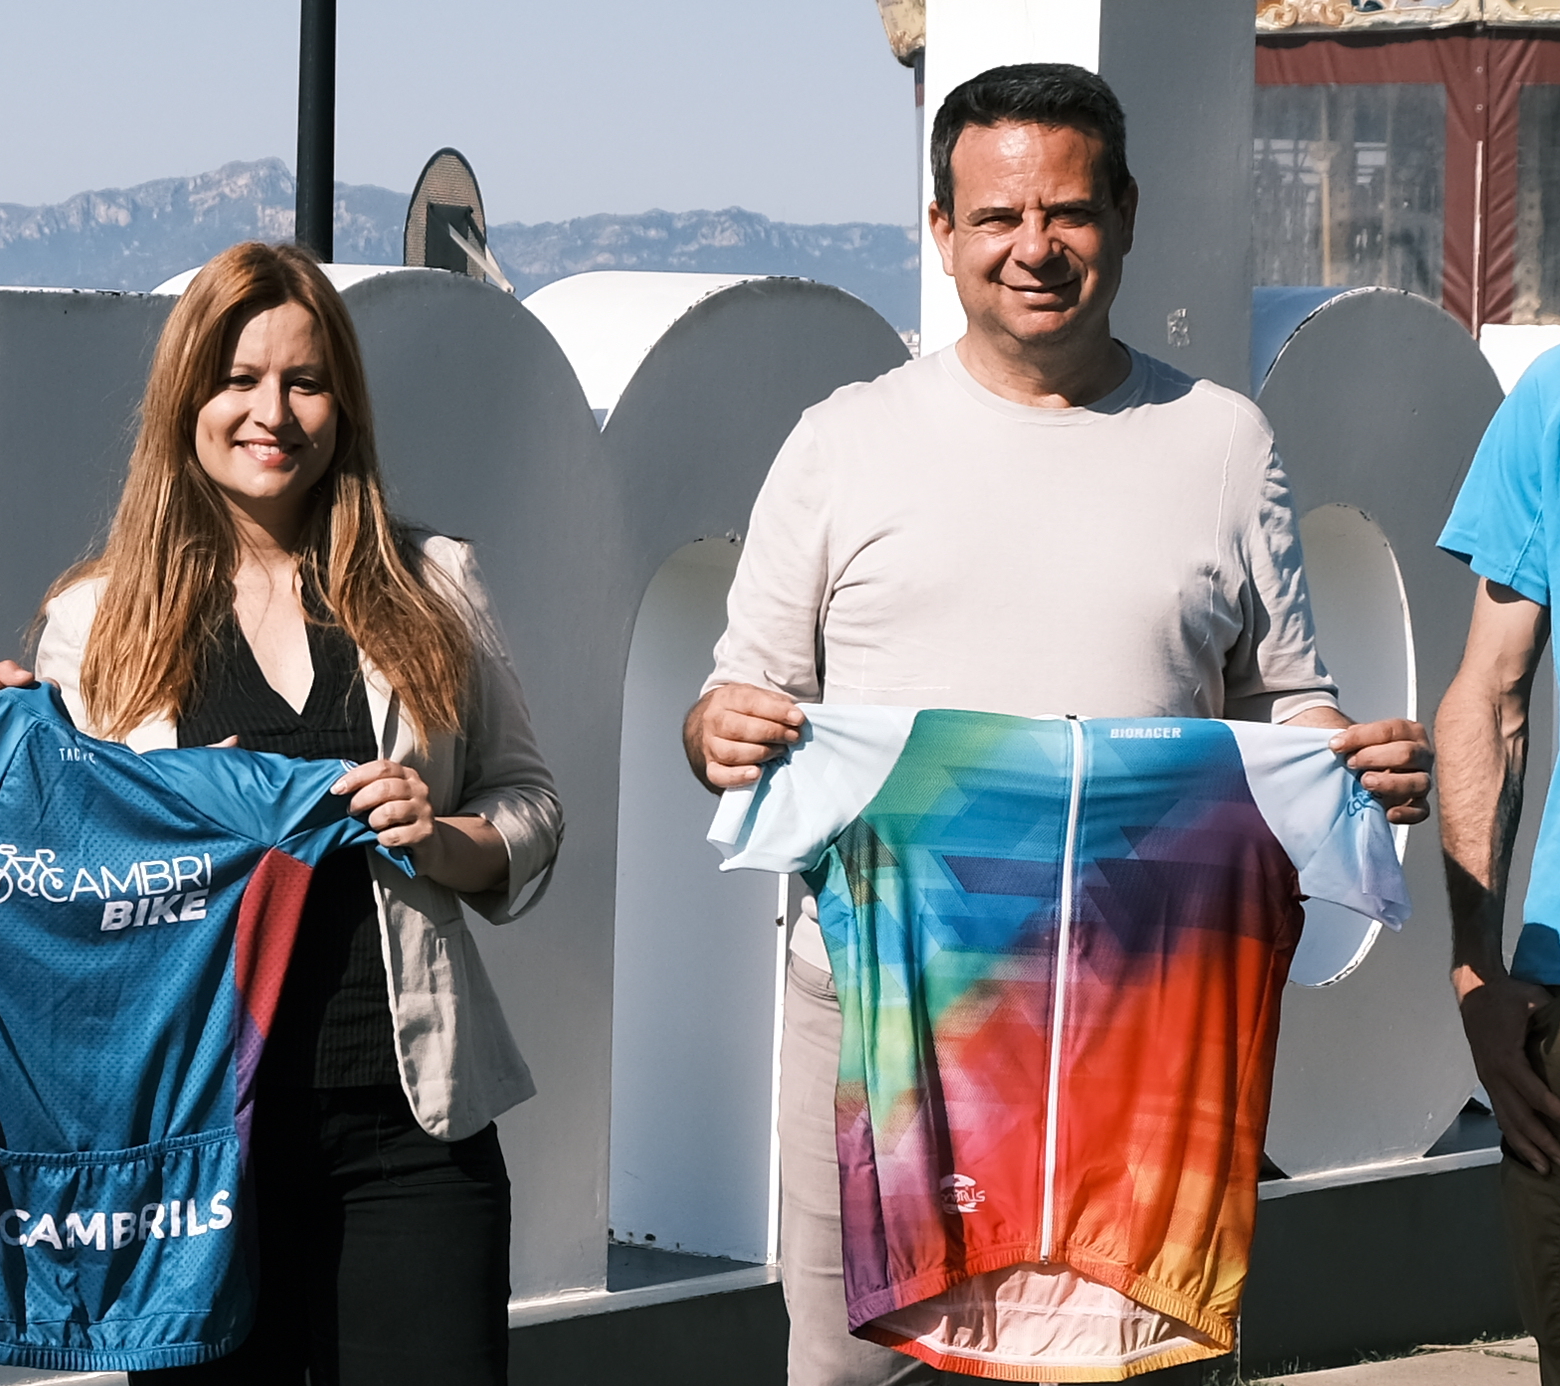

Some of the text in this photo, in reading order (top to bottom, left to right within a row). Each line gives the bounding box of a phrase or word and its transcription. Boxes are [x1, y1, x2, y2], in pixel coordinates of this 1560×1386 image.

[1110, 727, 1181, 739] BIORACER
[39, 853, 212, 903] CAMBRI
[100, 889, 210, 931] BIKE
